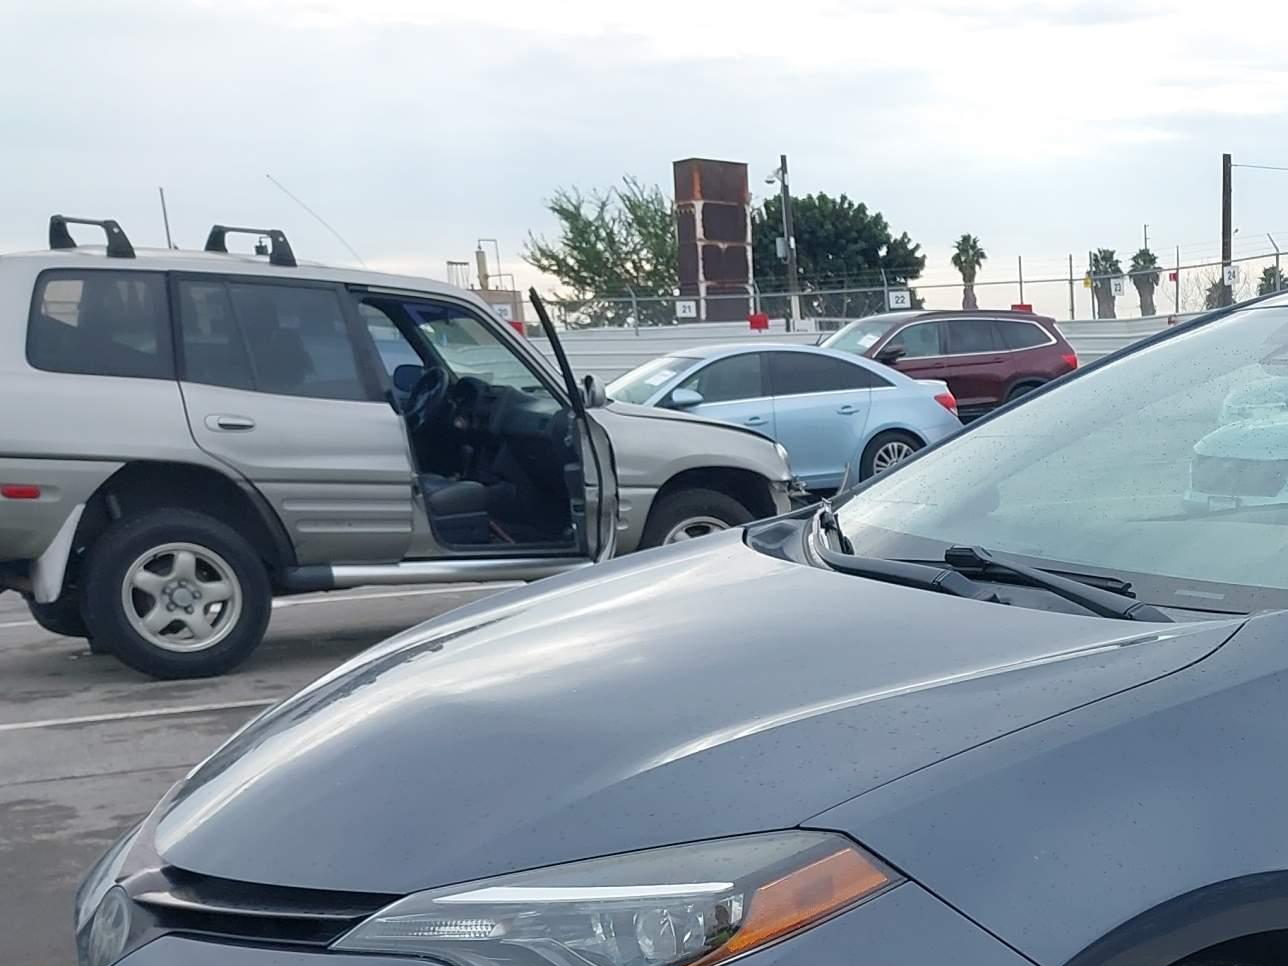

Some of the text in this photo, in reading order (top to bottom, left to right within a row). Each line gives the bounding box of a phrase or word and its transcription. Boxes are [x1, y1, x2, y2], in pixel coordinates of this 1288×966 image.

[1228, 270, 1237, 281] 24
[1114, 282, 1122, 293] 23
[894, 295, 906, 304] 22
[681, 304, 692, 314] 21
